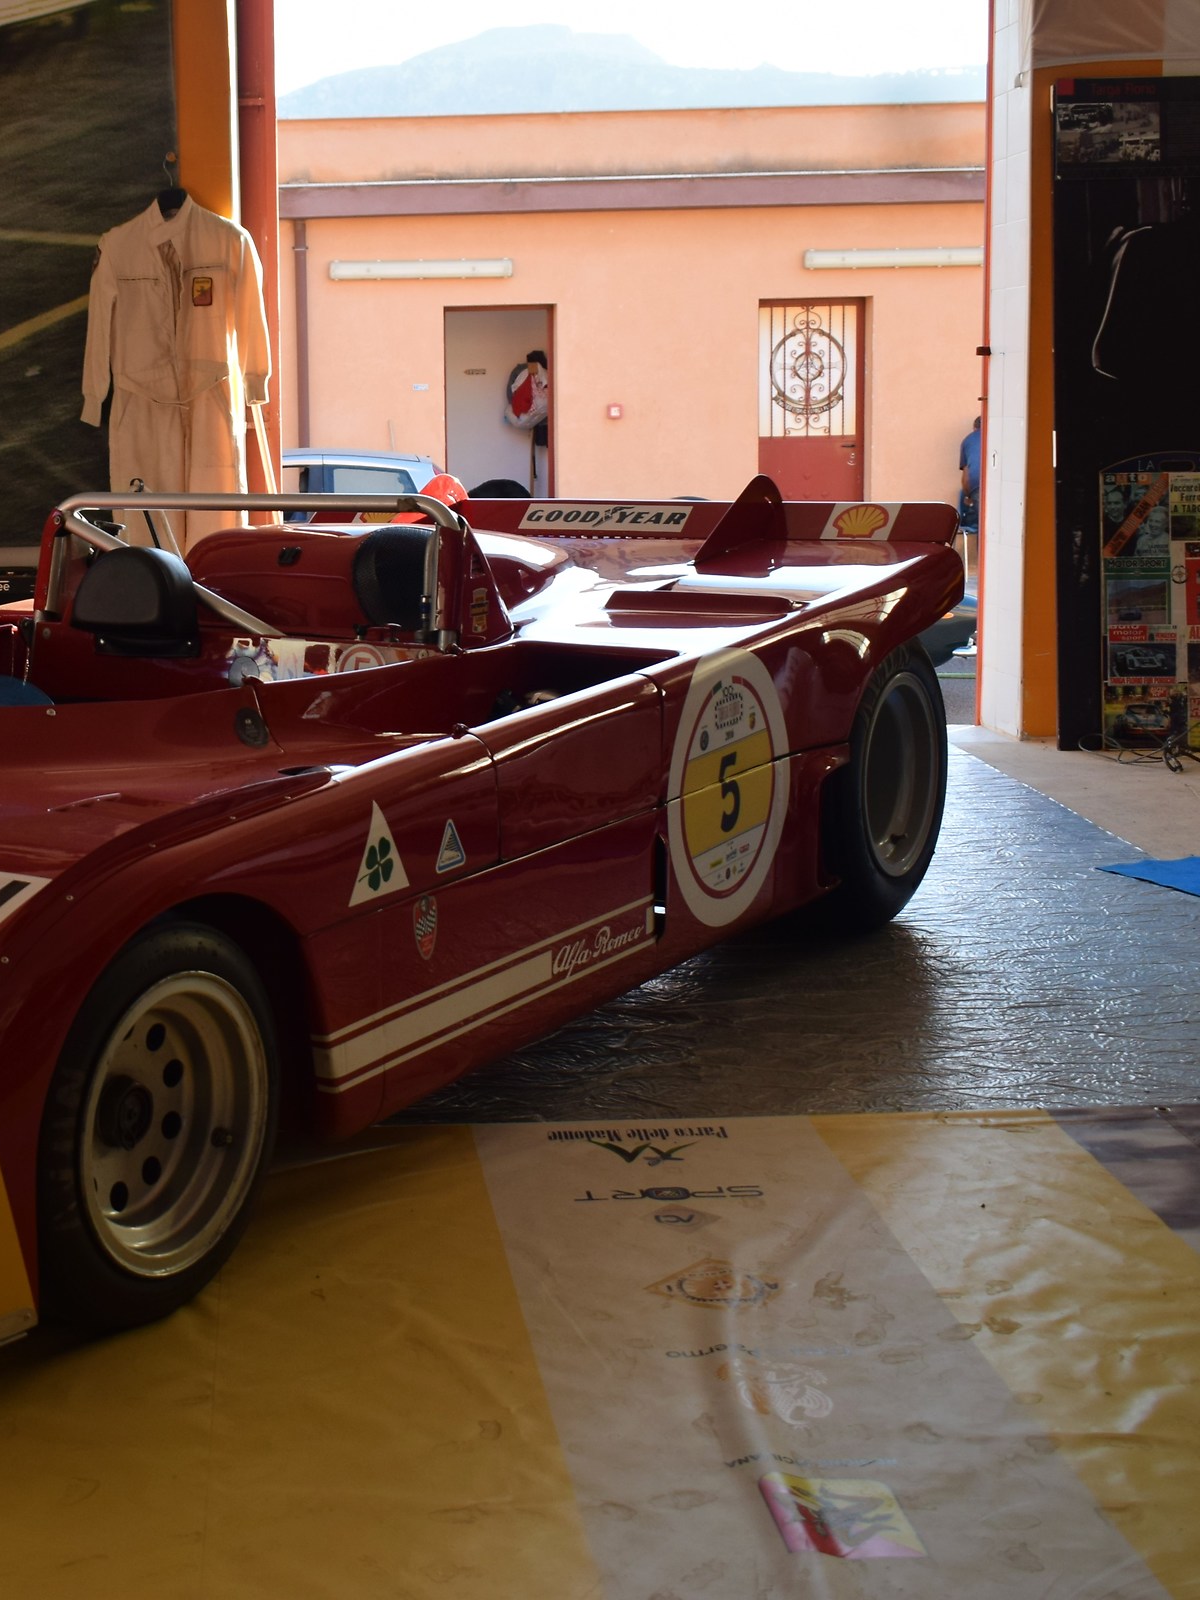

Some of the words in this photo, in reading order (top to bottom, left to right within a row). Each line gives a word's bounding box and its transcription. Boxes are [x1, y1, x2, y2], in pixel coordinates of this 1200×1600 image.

[1108, 559, 1138, 568] MOTOR
[1139, 558, 1167, 568] SPORT
[719, 750, 740, 833] 5
[552, 944, 593, 980] Alfa
[593, 924, 645, 958] Romeo
[547, 1128, 622, 1142] Madonie
[626, 1127, 670, 1141] delle
[675, 1126, 728, 1140] Parco
